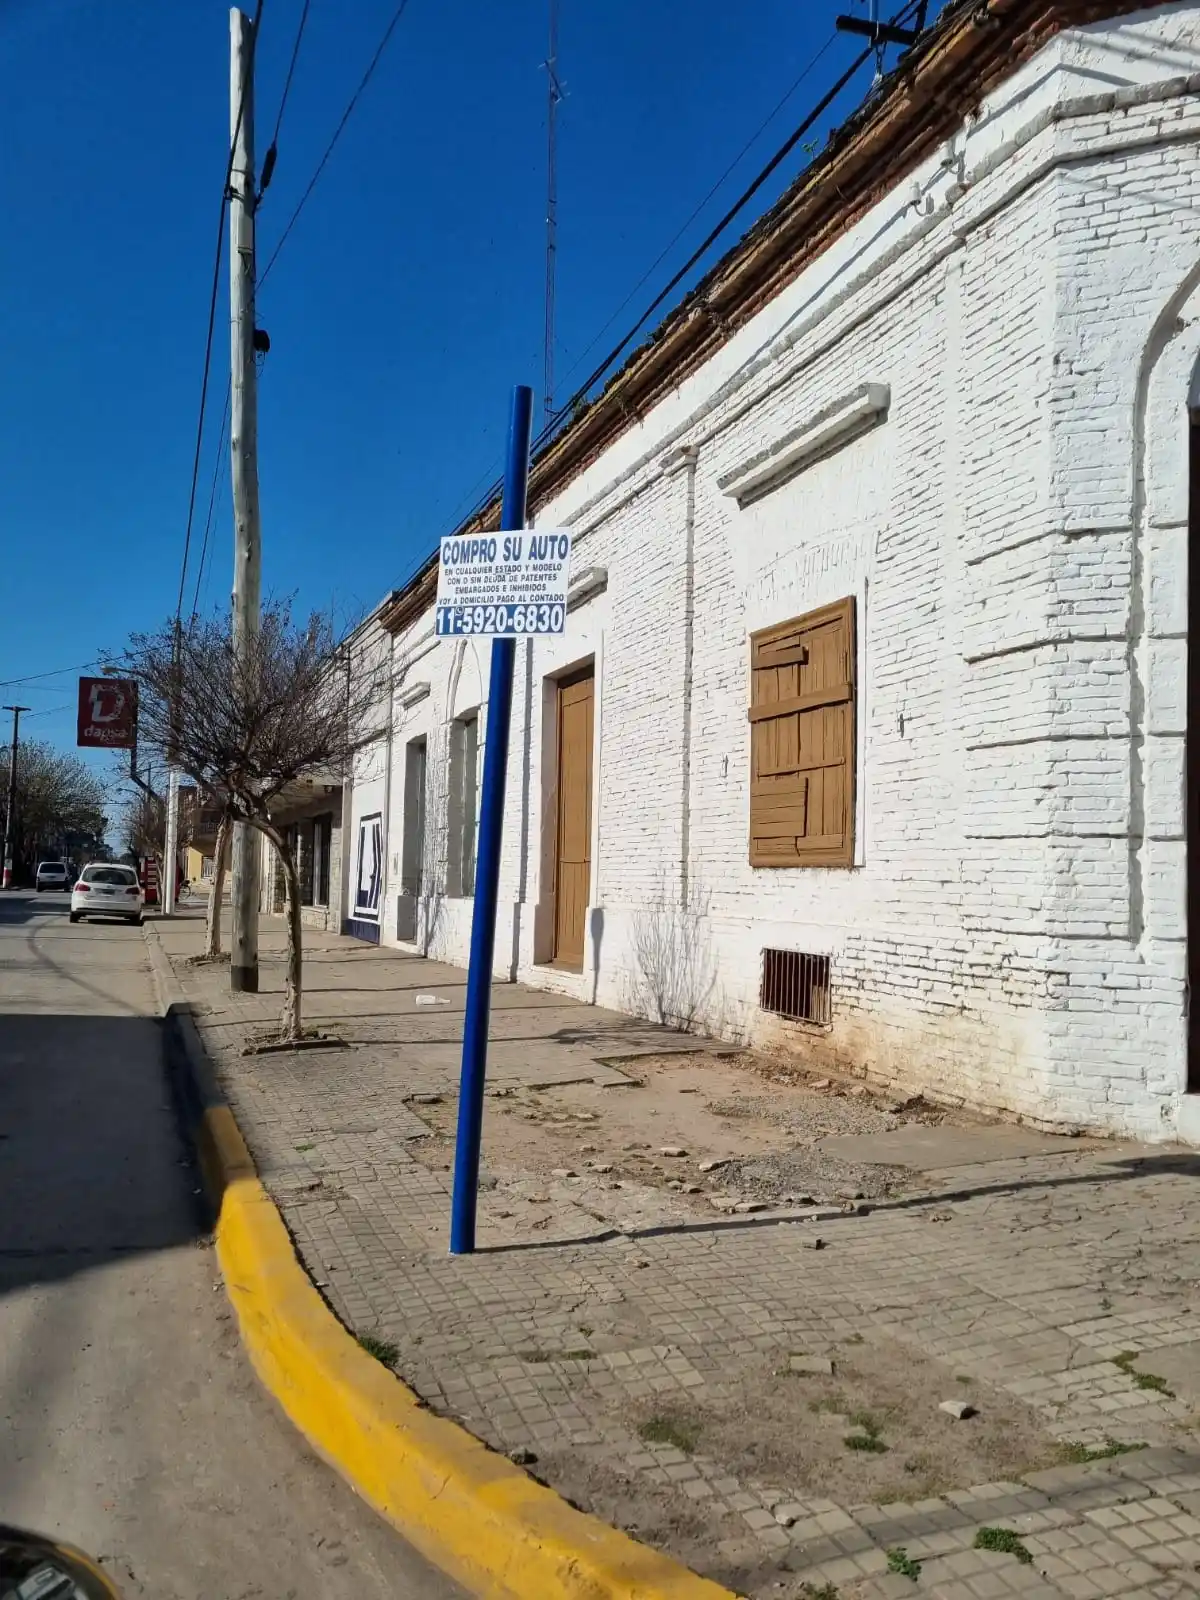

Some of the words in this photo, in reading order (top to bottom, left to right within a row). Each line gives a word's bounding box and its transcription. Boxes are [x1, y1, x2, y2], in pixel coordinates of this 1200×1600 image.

[442, 538, 496, 565] COMPRO
[503, 537, 522, 562] SU
[528, 534, 568, 560] AUTO
[455, 566, 493, 575] CUALQUIER
[495, 564, 522, 573] ESTADO
[532, 563, 562, 571] MODELO
[448, 577, 461, 585] CON
[471, 576, 481, 584] SIN
[484, 575, 505, 583] DEUDA
[508, 574, 518, 582] DE
[521, 573, 557, 582] PATENTES
[455, 584, 500, 594] EMBARGADOS
[502, 584, 506, 592] E
[510, 584, 546, 592] INHIBIDOS
[460, 596, 494, 604] DOMICILIO
[518, 594, 526, 602] AL
[530, 594, 564, 602] CONTADO
[437, 604, 562, 633] 11-5920-6830
